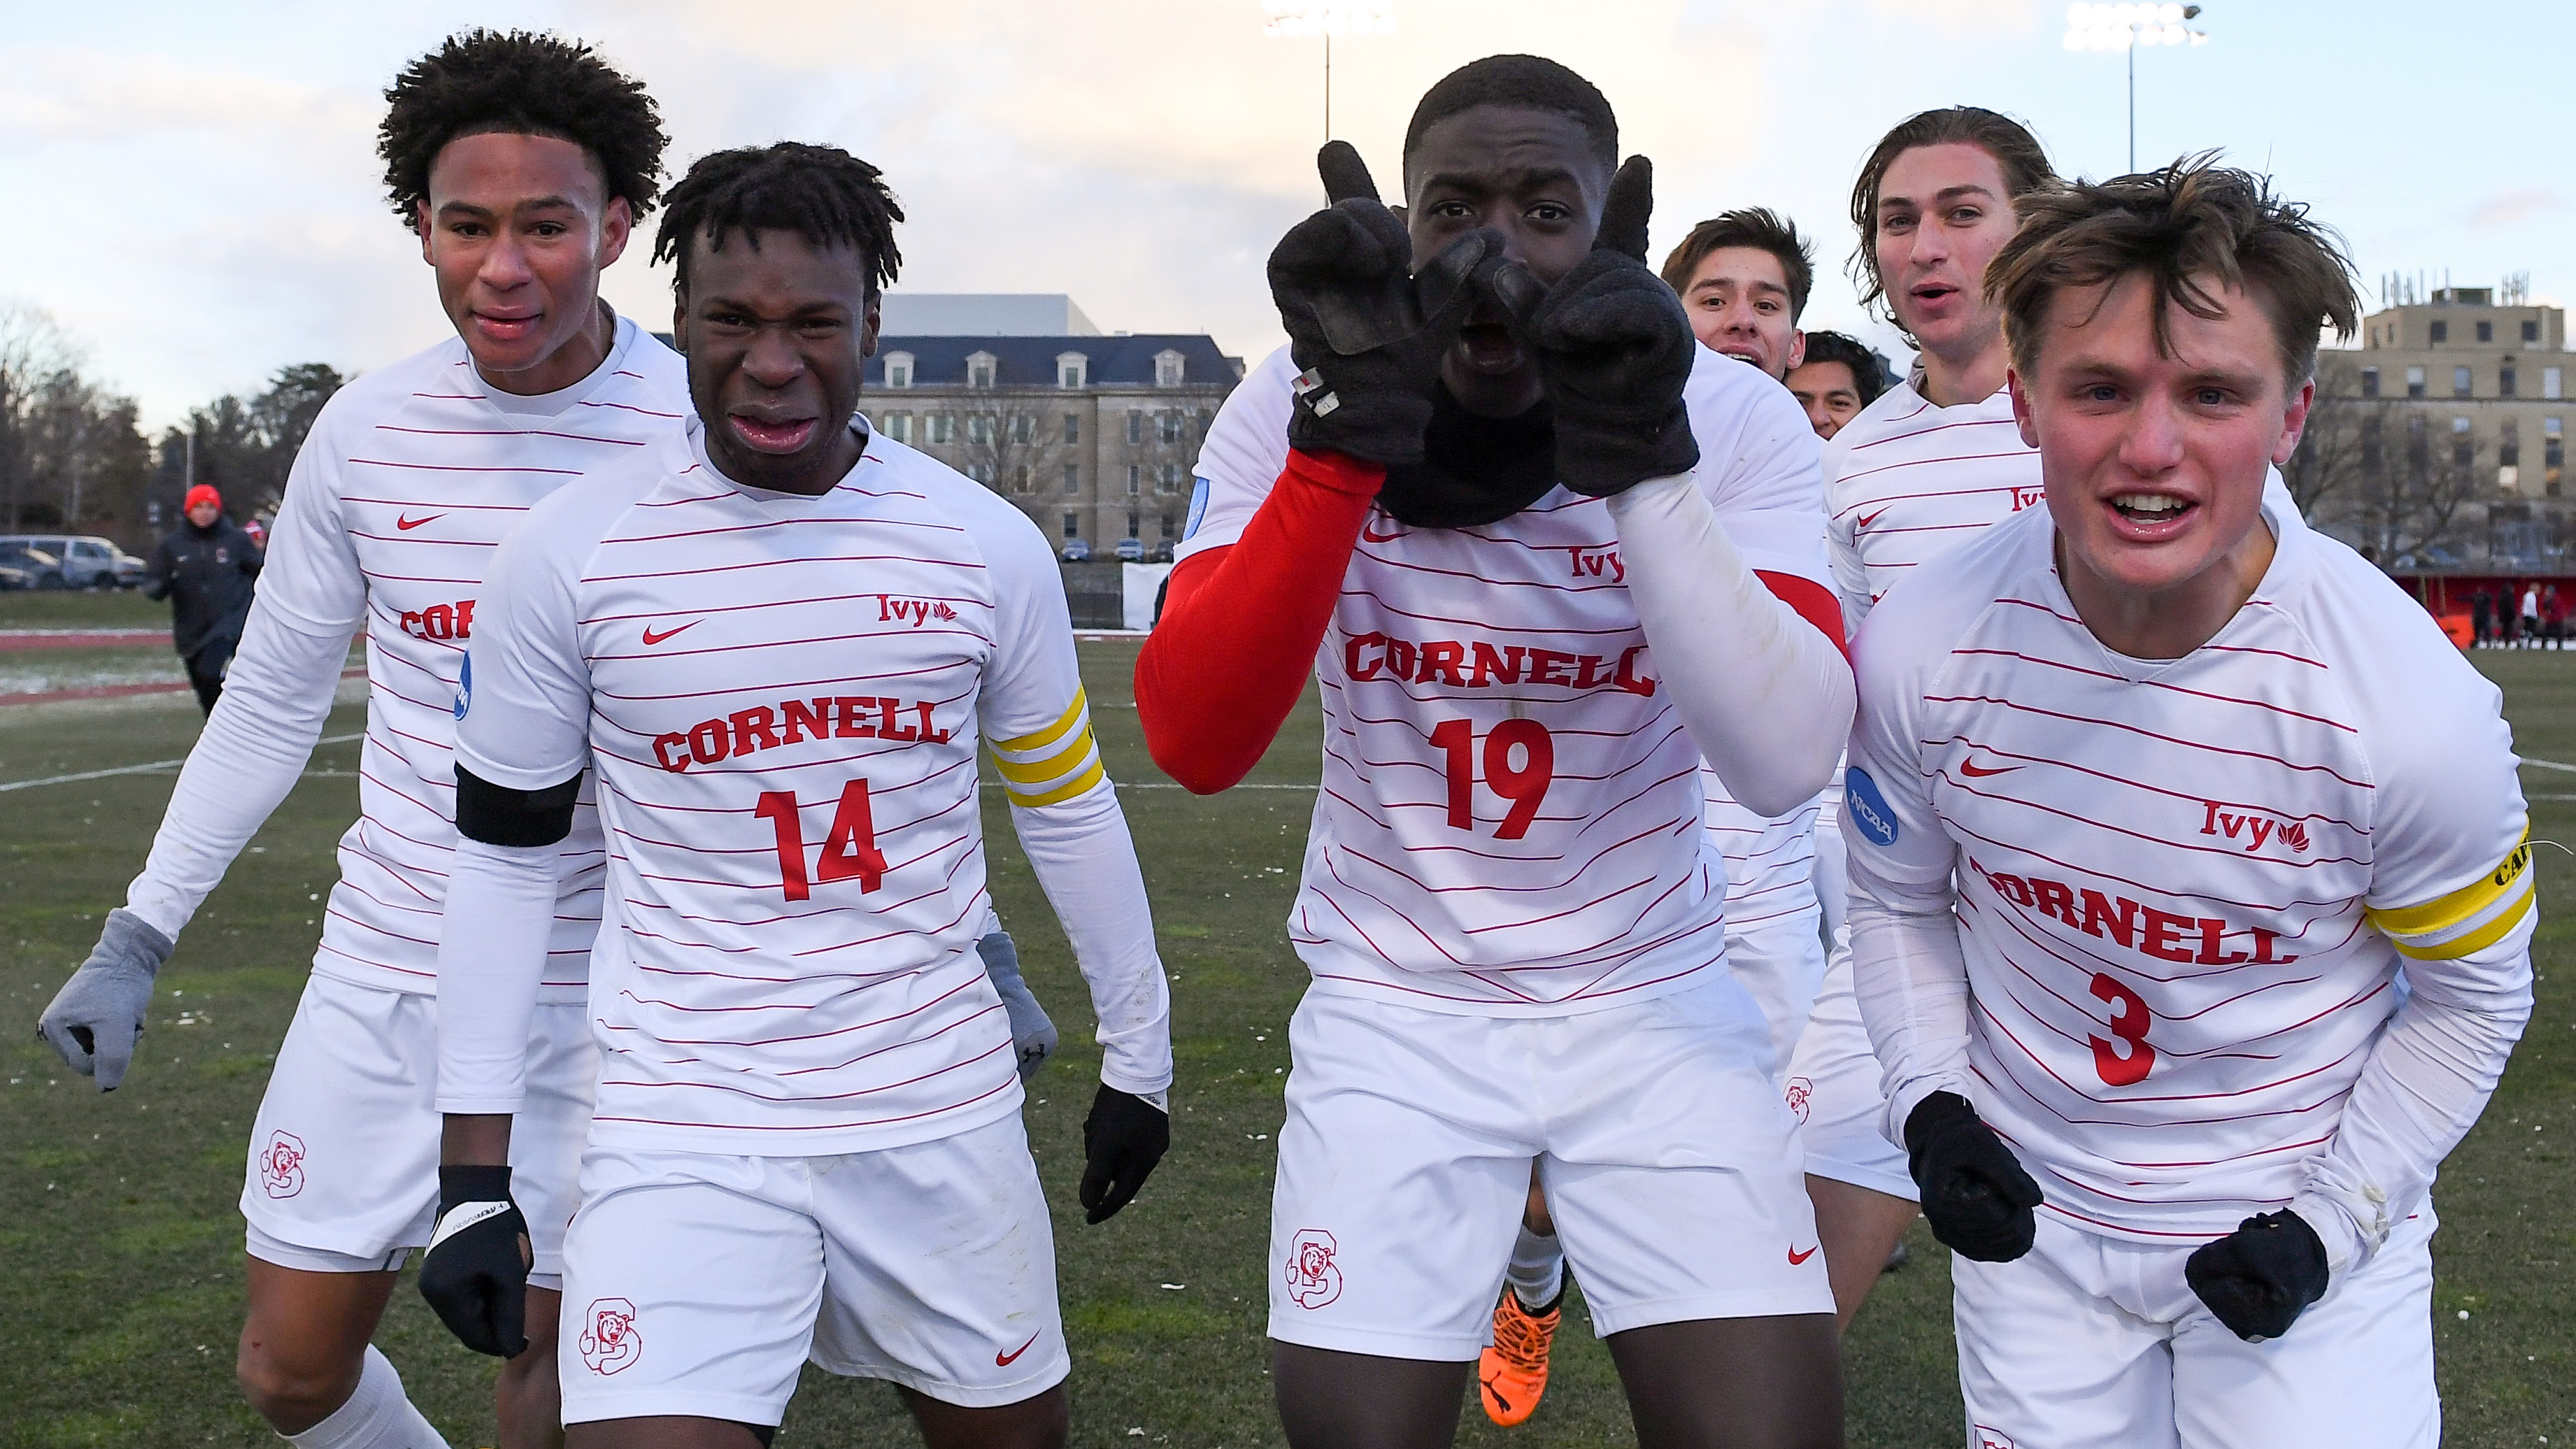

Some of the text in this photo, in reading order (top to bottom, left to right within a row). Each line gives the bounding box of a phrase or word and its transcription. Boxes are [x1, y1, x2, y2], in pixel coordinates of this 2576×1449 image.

[2010, 487, 2047, 512] Iv
[876, 594, 930, 627] Ivy
[1344, 631, 1656, 697] CORNELL
[653, 697, 949, 773] CORNELL
[1428, 718, 1554, 840] 19
[754, 778, 888, 902] 14
[1851, 790, 1893, 841] NCAA
[2200, 800, 2275, 851] Ivy
[2087, 972, 2156, 1087] 3
